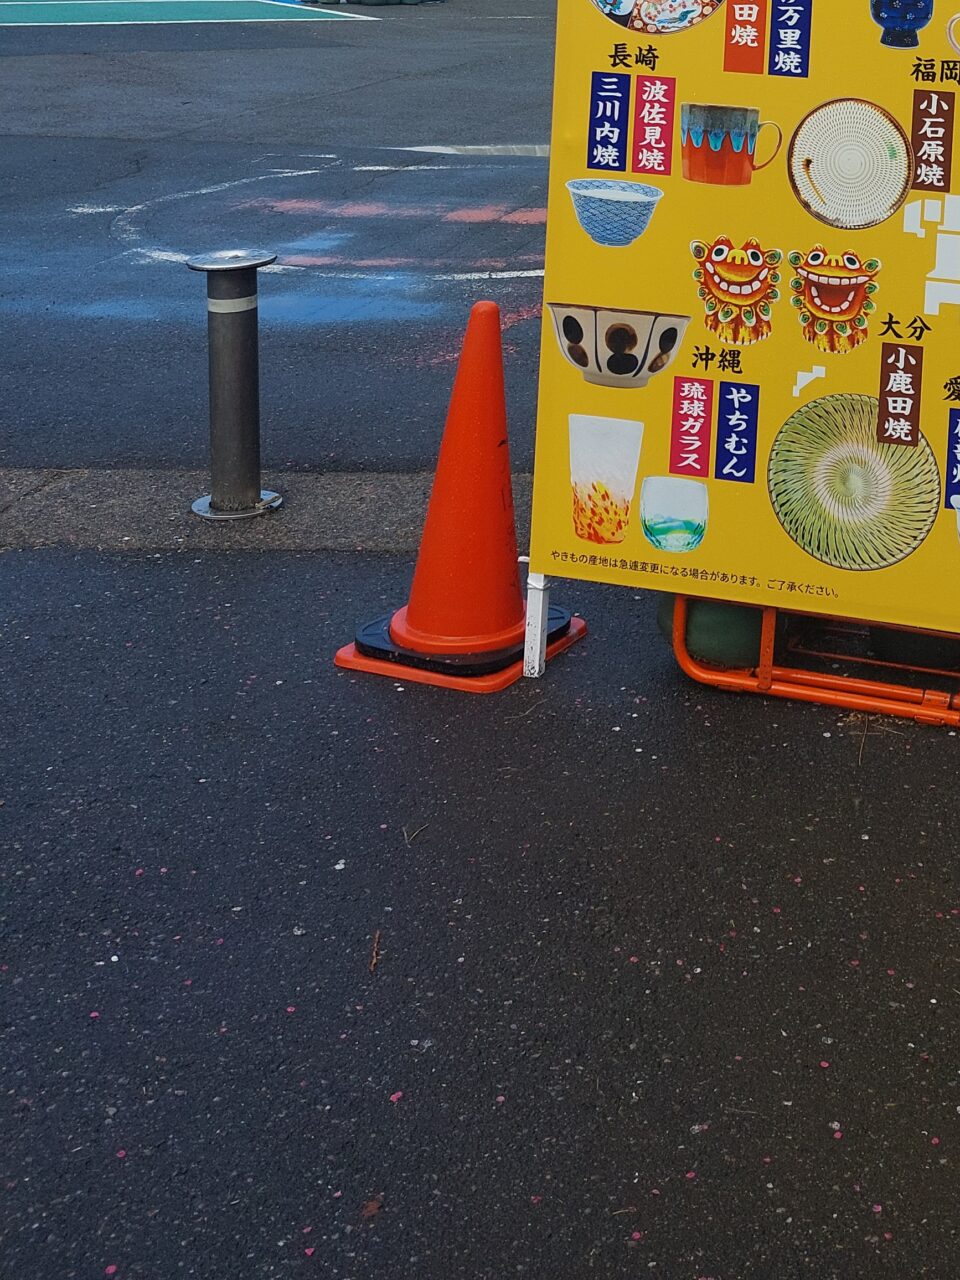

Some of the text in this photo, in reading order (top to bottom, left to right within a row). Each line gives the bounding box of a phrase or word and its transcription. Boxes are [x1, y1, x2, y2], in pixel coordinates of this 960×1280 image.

[607, 42, 660, 72] 長崎
[593, 77, 622, 168] 三川内焼
[638, 80, 669, 171] 波佐見焼
[915, 93, 949, 187] 小石原焼
[691, 344, 743, 375] 沖縄
[878, 312, 932, 342] 大分
[677, 382, 707, 470] 琉球ガラス
[722, 387, 752, 477] やちむん
[883, 347, 917, 441] 小鹿田焼
